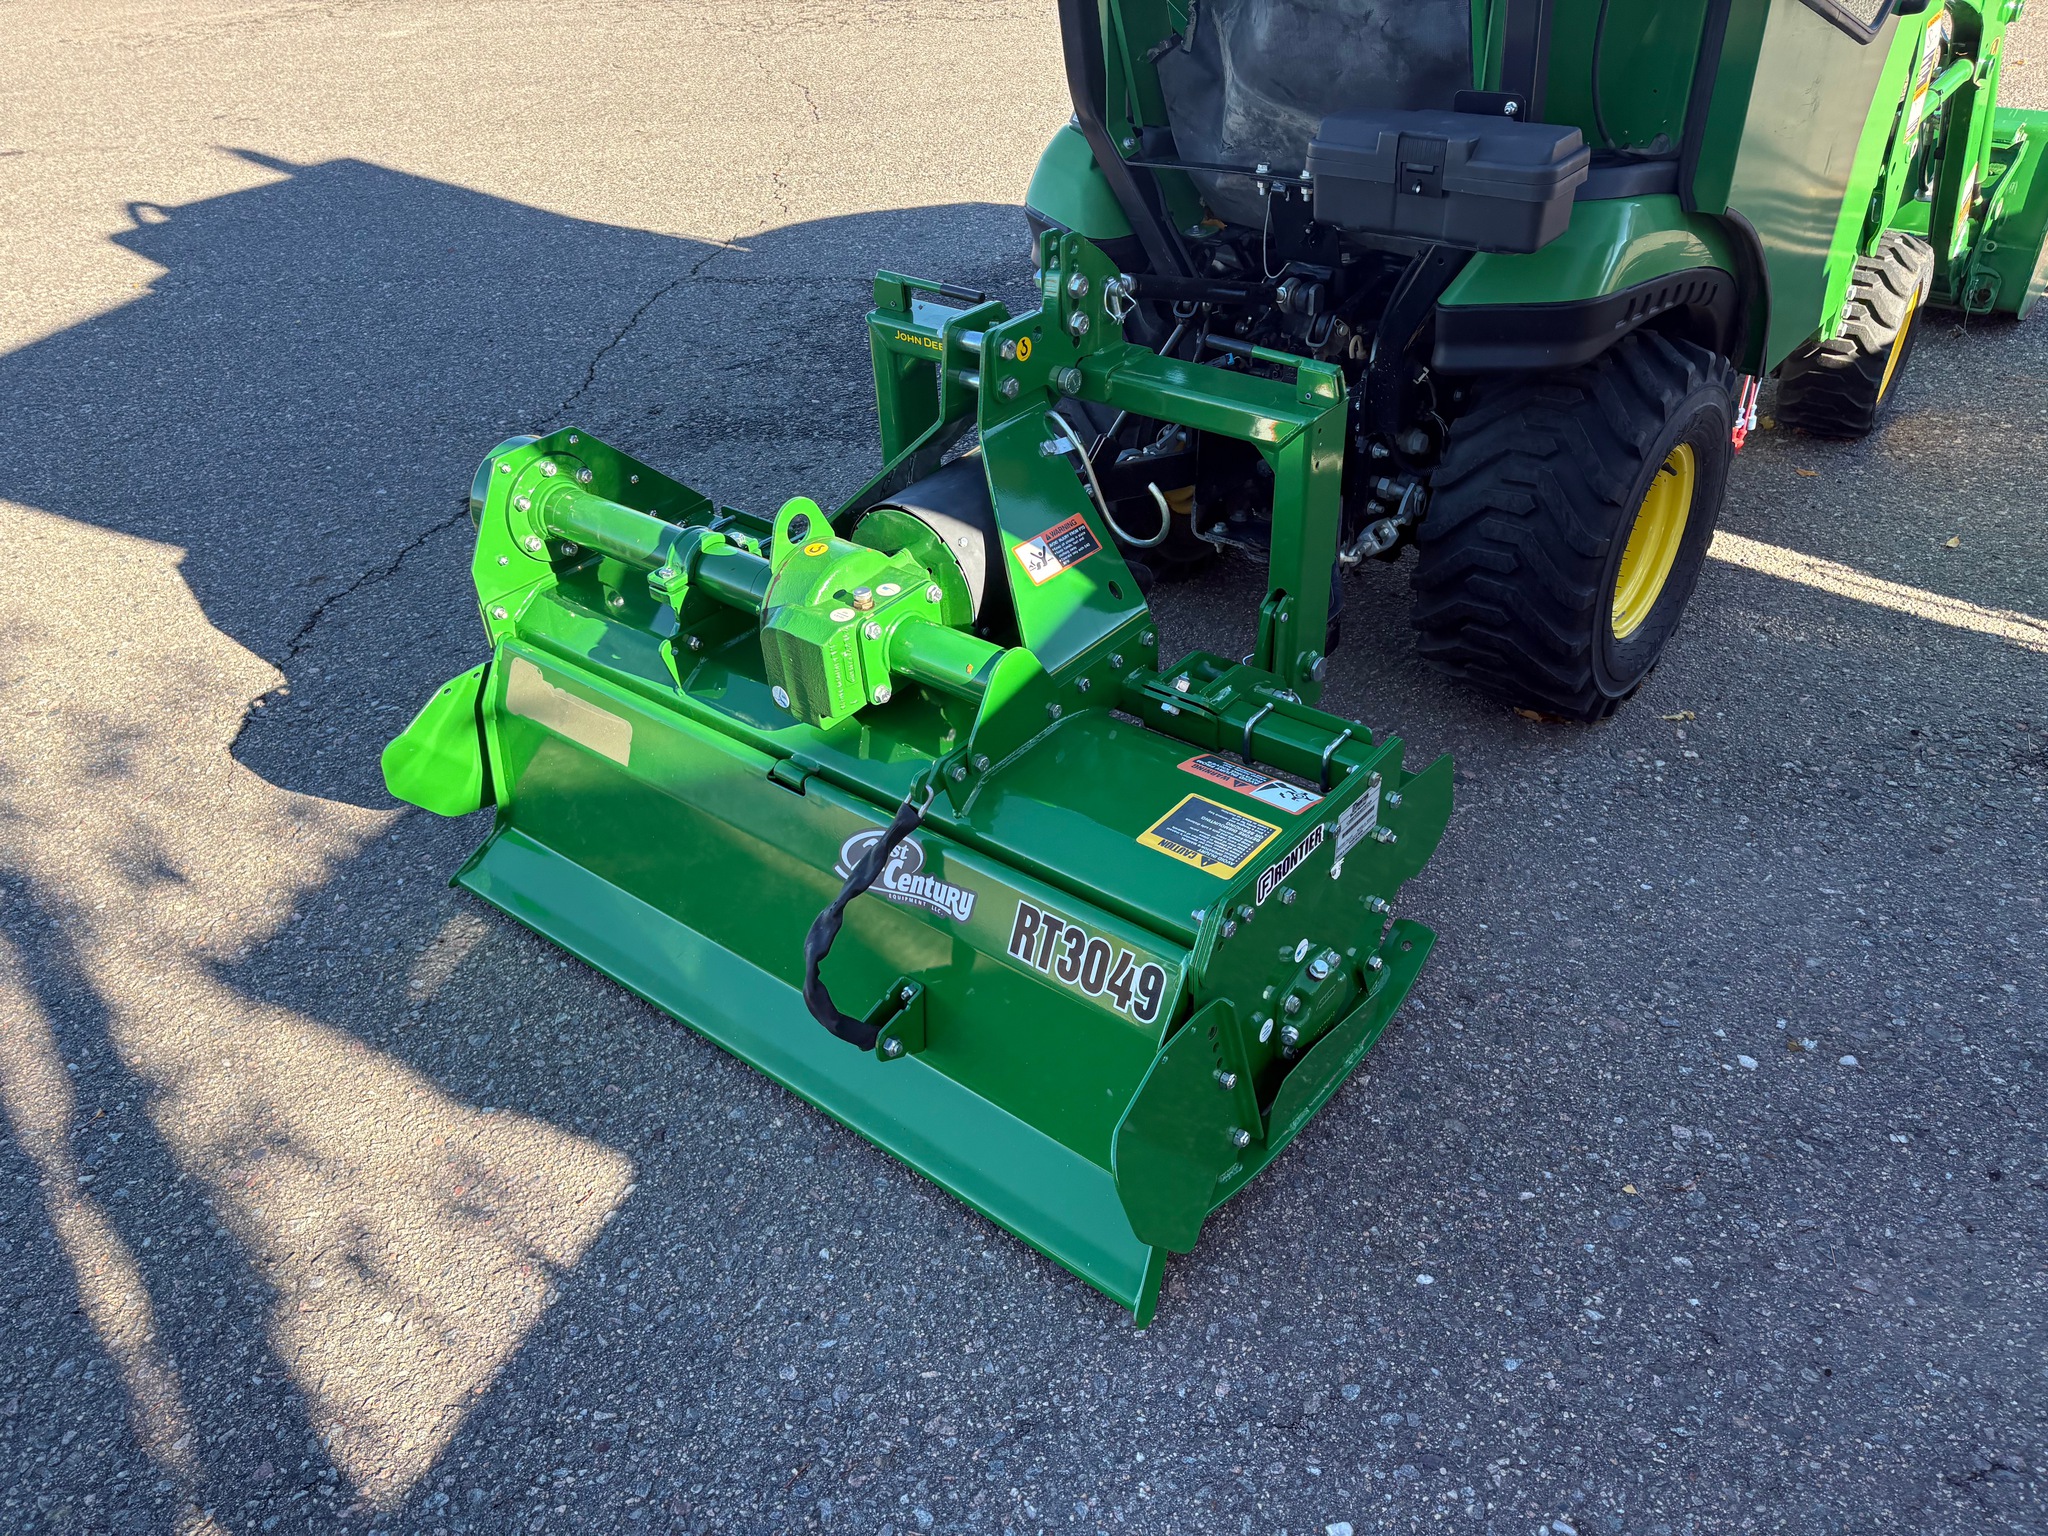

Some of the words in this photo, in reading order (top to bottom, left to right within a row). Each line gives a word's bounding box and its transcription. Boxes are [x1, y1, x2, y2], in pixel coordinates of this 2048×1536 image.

[895, 330, 922, 346] JOHN
[923, 337, 943, 351] DEE
[1050, 519, 1077, 538] WARNING
[1191, 763, 1230, 781] WARNING
[1158, 839, 1198, 860] CAUTION
[1257, 824, 1324, 905] FRONTIER
[888, 893, 927, 907] EQUIPMENT
[931, 905, 944, 916] LLC.
[1007, 899, 1167, 1024] RT3049
